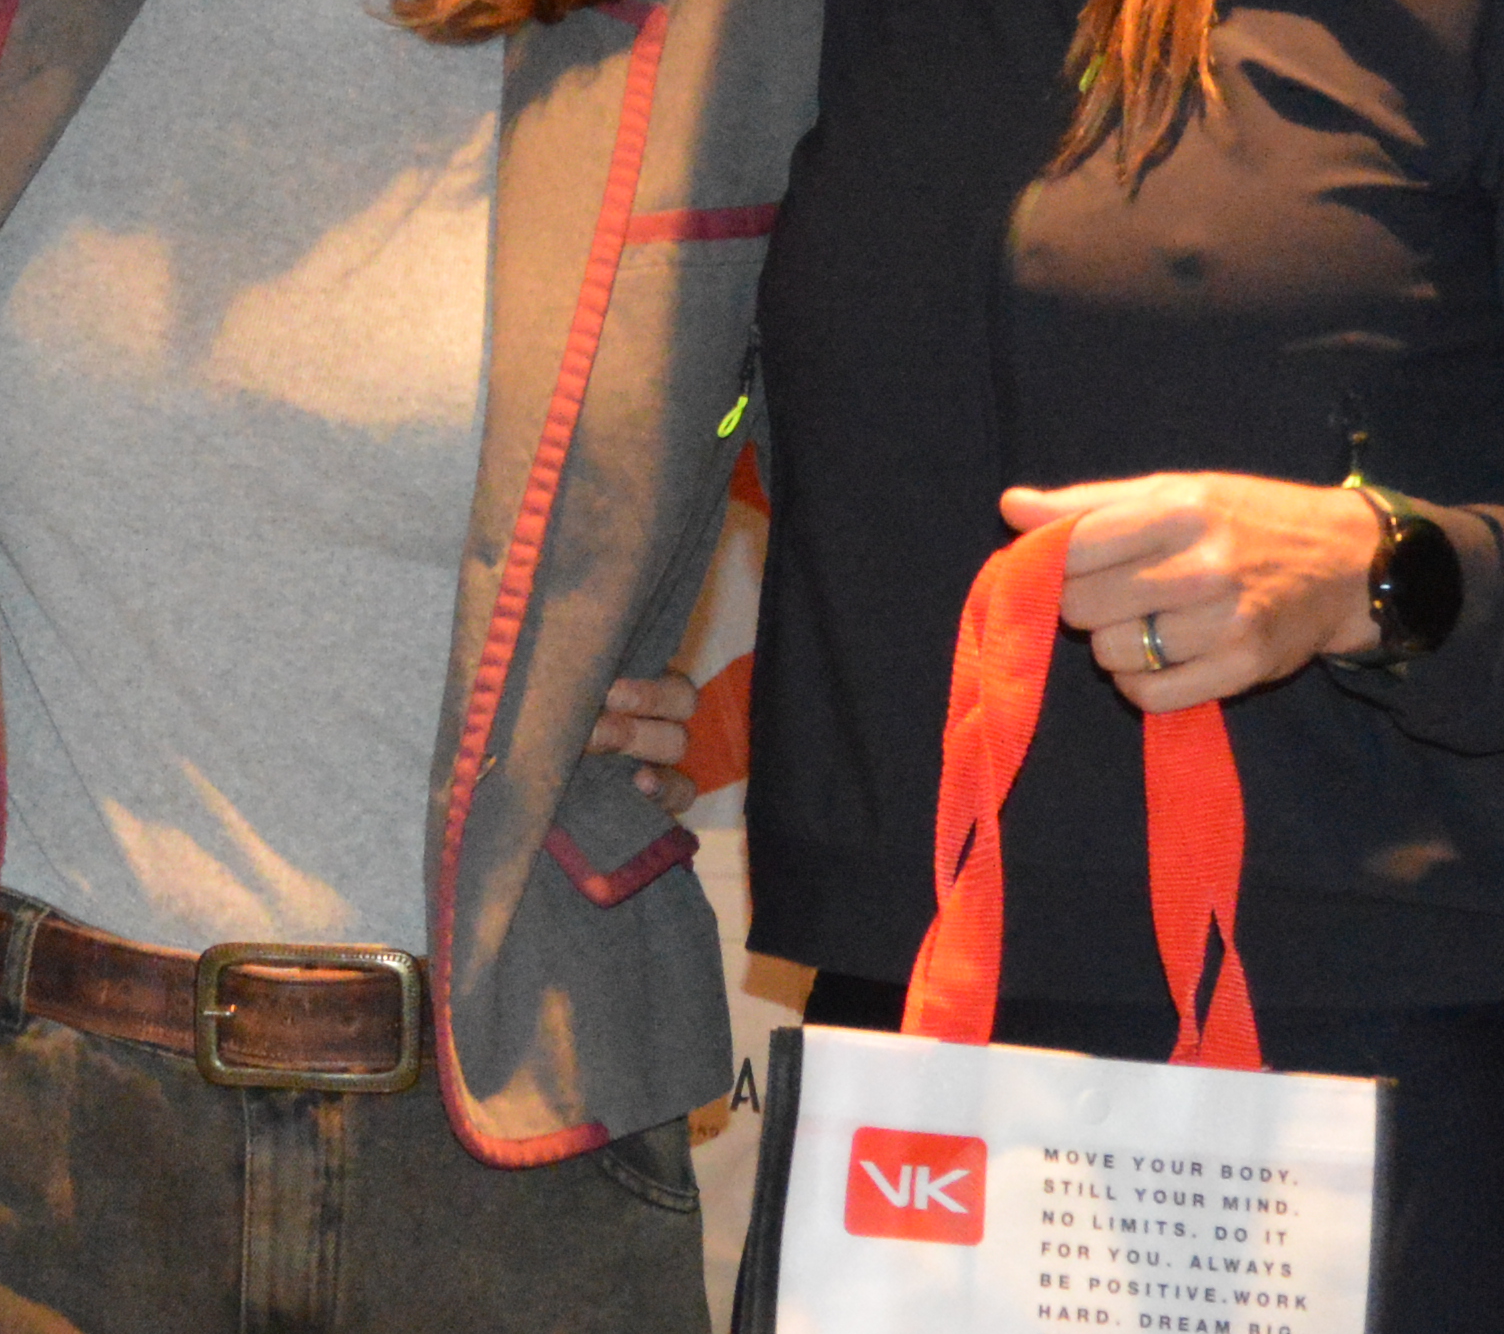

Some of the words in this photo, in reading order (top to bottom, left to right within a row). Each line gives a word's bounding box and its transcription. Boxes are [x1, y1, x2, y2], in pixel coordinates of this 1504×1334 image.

[1043, 1147, 1115, 1170] MOVE
[1132, 1156, 1204, 1178] YOUR
[1220, 1163, 1297, 1185] BODY.
[1042, 1177, 1117, 1202] STILL
[1134, 1188, 1206, 1209] YOUR
[1221, 1193, 1302, 1219] MIND.
[1041, 1209, 1075, 1228] NO
[1092, 1215, 1197, 1239] LIMITS.
[1213, 1225, 1248, 1243] DO
[1263, 1229, 1288, 1247] IT
[1040, 1240, 1091, 1261] FOR
[1108, 1247, 1172, 1268] YOU.
[1188, 1254, 1292, 1280] ALWAYS
[1039, 1272, 1071, 1291] BE
[1036, 1302, 1123, 1329] HARD.
